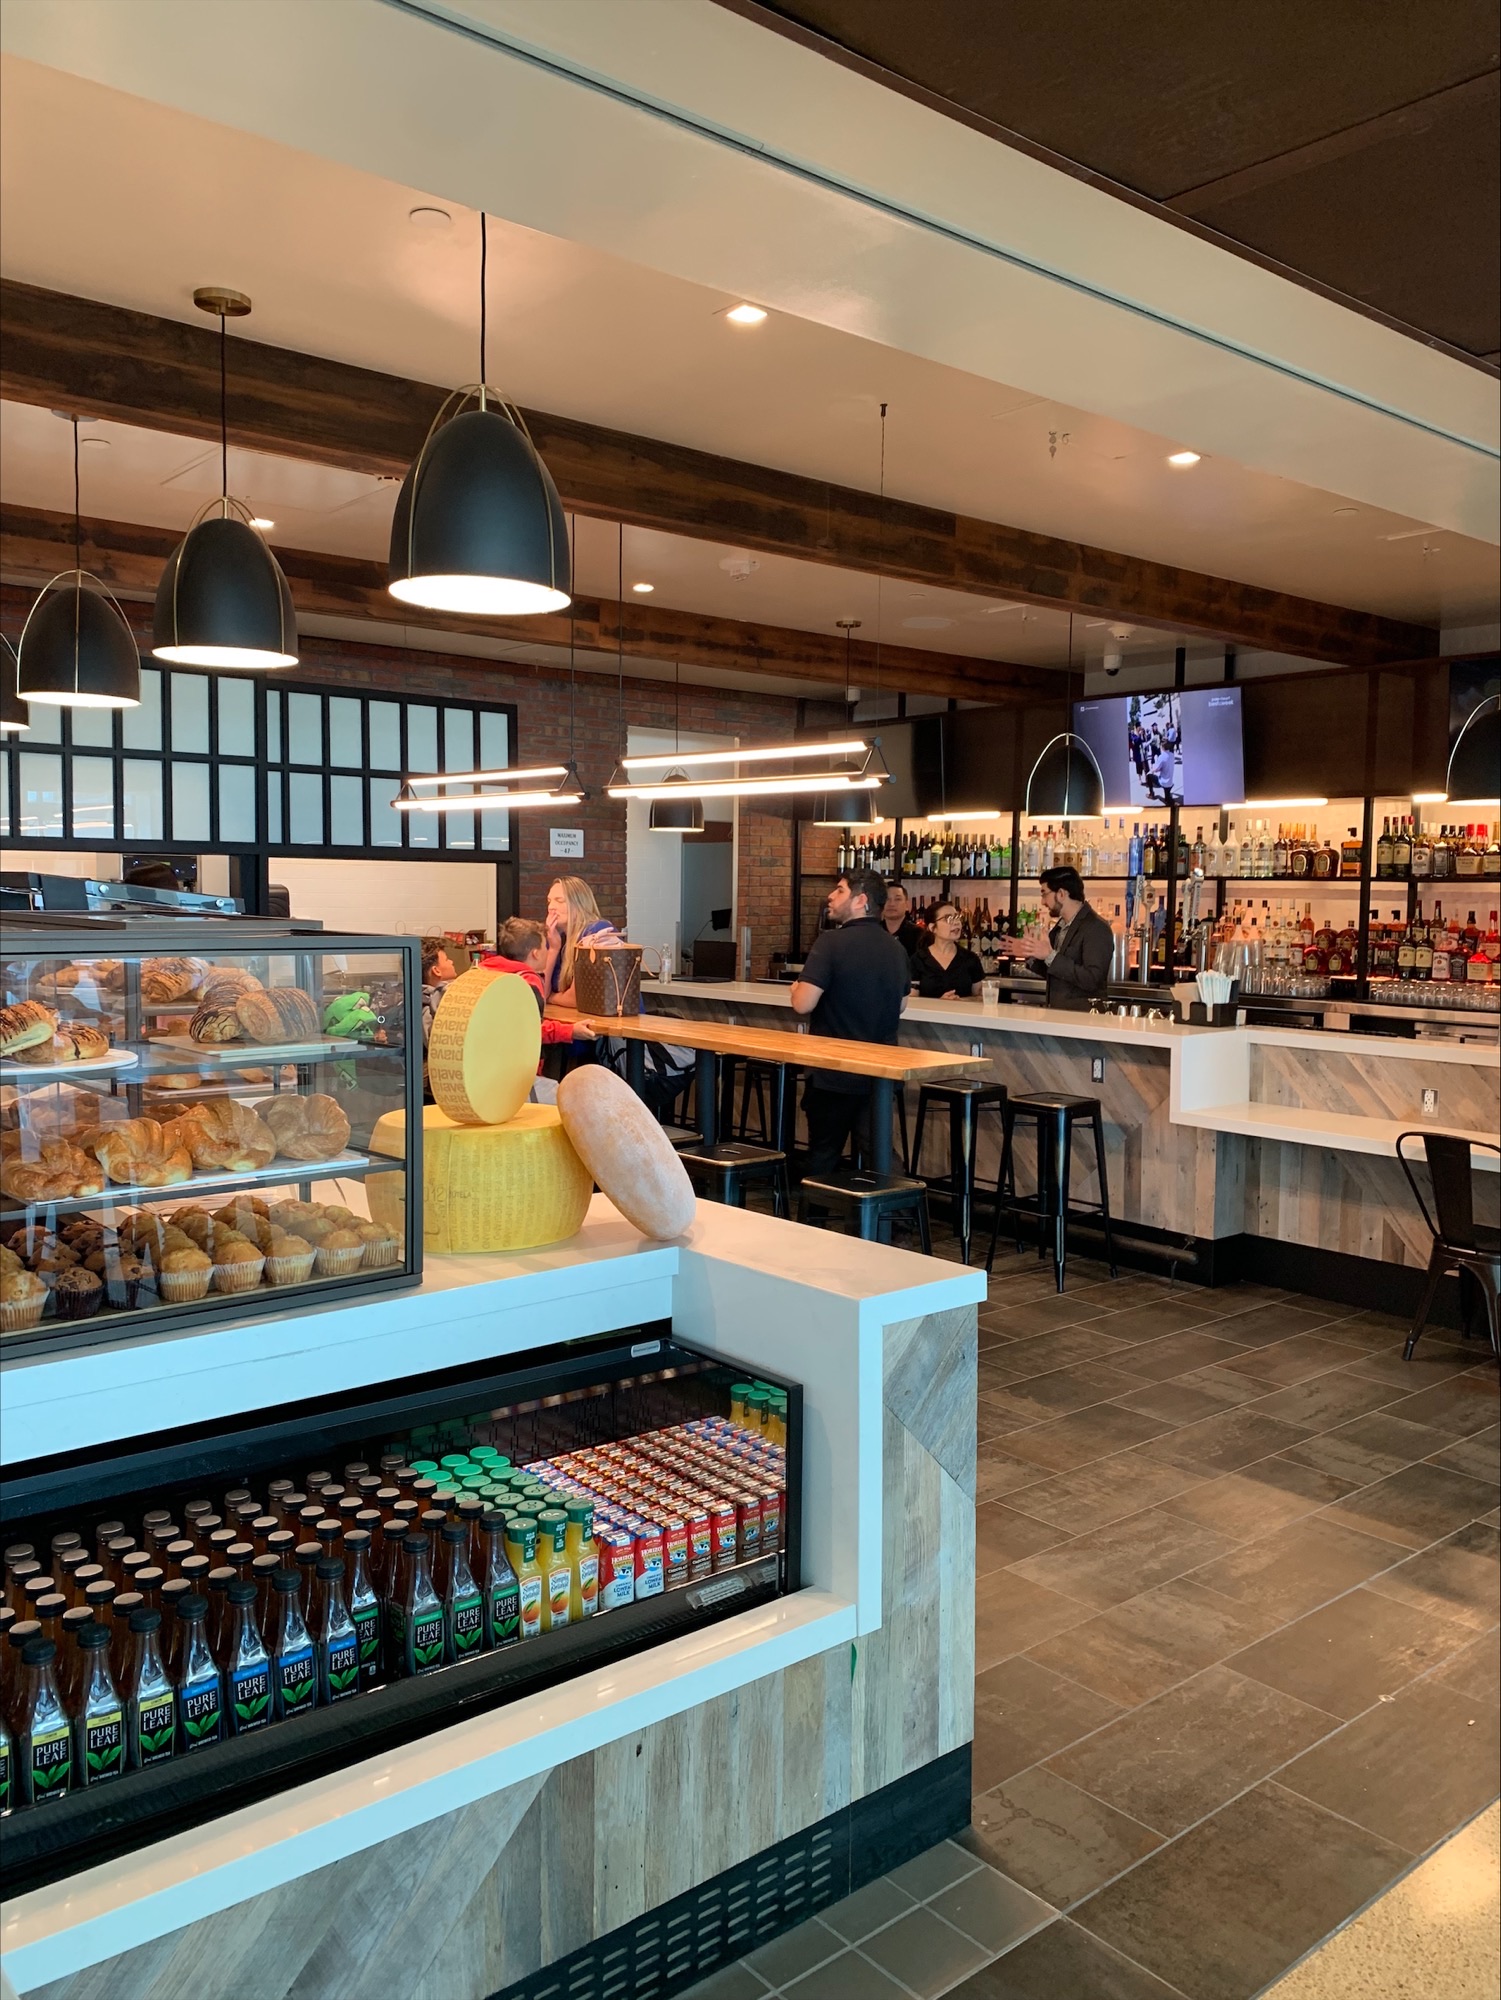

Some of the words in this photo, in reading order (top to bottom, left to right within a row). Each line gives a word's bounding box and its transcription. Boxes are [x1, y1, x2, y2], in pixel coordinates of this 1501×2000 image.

[430, 1032, 464, 1046] piave
[430, 1048, 464, 1061] piave
[496, 1595, 518, 1609] PURE
[457, 1607, 480, 1620] PURE
[496, 1604, 518, 1617] LEAF
[417, 1621, 440, 1635] PURE
[457, 1616, 480, 1629] LEAF
[417, 1630, 440, 1643] LEAF
[332, 1648, 355, 1662] PURE
[284, 1659, 310, 1677] PURE
[332, 1657, 355, 1670] LEAF
[238, 1675, 266, 1692] PURE
[284, 1668, 311, 1685] LEAF
[187, 1691, 215, 1709] PURE
[239, 1685, 266, 1700] LEAF
[143, 1705, 171, 1721] PURE
[188, 1700, 216, 1718] LEAF
[144, 1715, 171, 1731] LEAF
[90, 1724, 118, 1739] PURE
[36, 1740, 67, 1756] PURE
[90, 1734, 119, 1749] LEAF
[36, 1750, 67, 1766] LEAF
